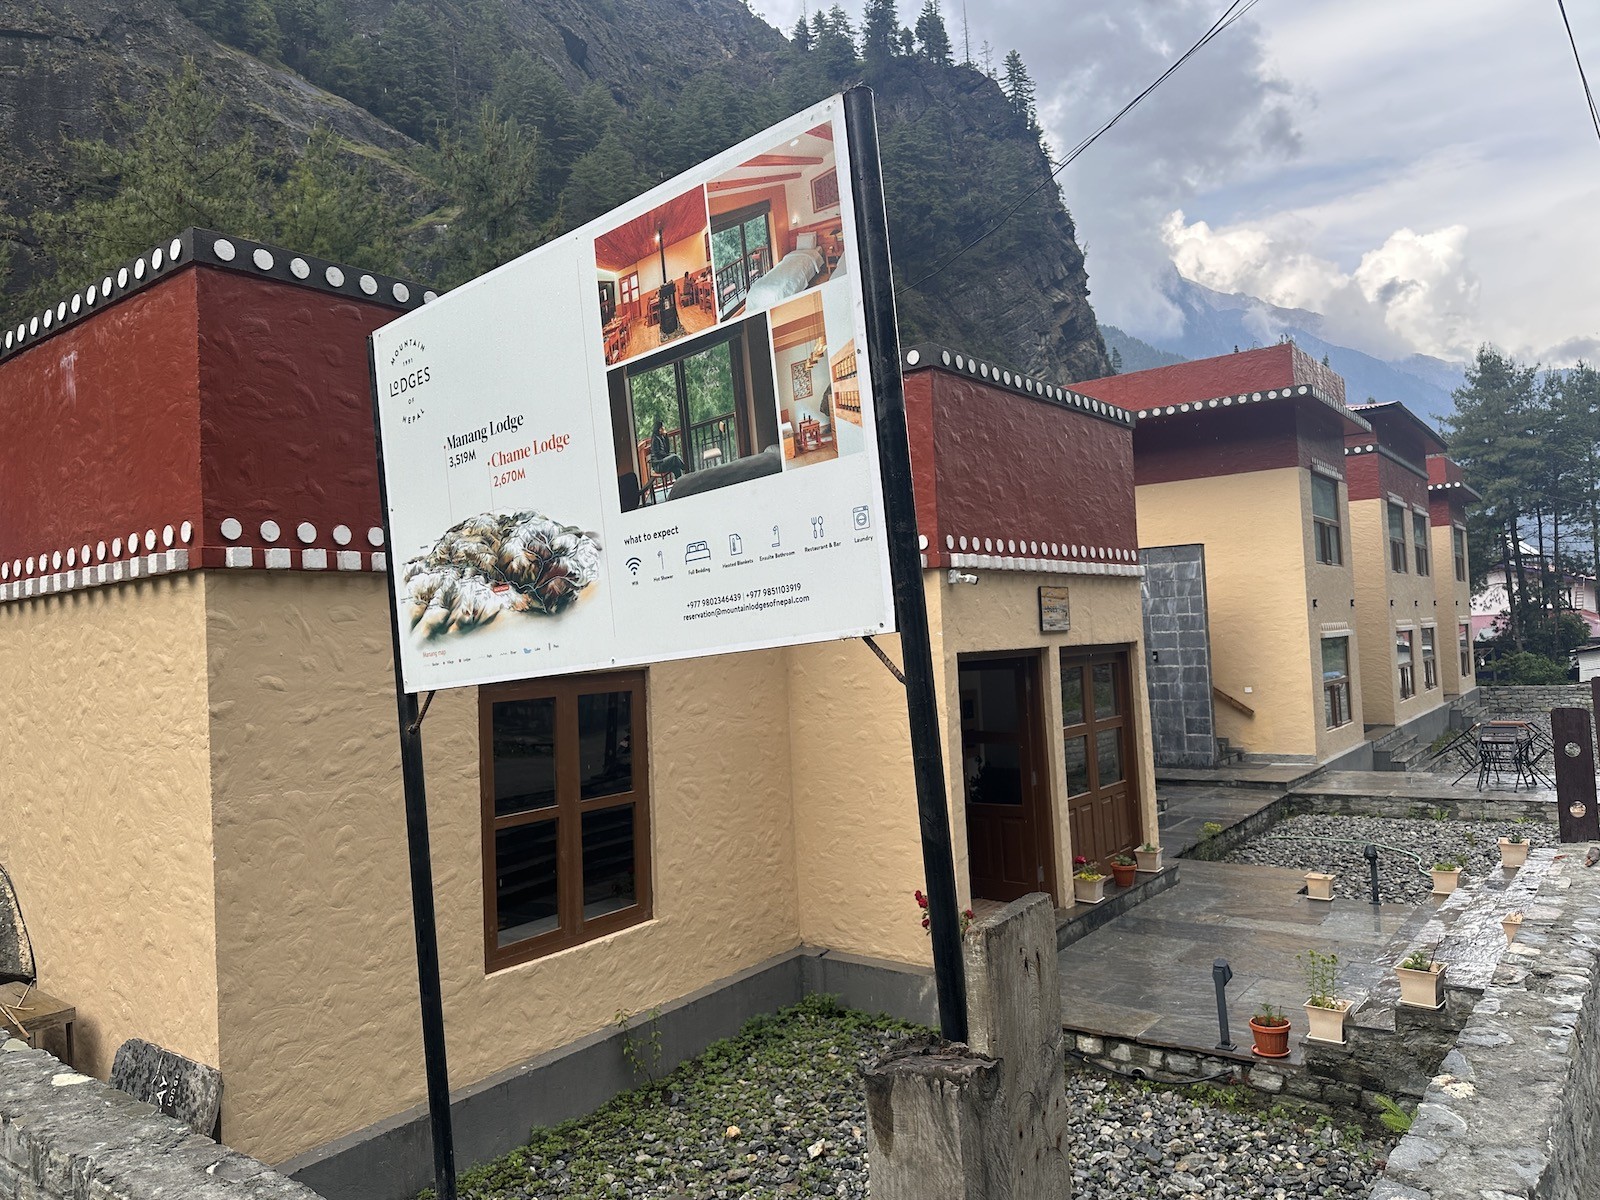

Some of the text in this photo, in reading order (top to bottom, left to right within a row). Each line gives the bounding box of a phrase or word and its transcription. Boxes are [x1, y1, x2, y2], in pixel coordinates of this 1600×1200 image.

[391, 339, 425, 366] MOUNTAIN
[408, 397, 415, 405] OF
[402, 408, 425, 424] NEPAL
[447, 414, 524, 451] Manang Lodge
[449, 448, 477, 468] 3,519M
[491, 433, 570, 468] Chame Lodge
[493, 468, 526, 488] 2,670M
[623, 525, 679, 545] what to expect
[853, 534, 873, 544] Laundry
[759, 550, 796, 562] Ensuite Bathroom
[804, 543, 828, 553] Restaurant
[737, 558, 754, 566] Blankets
[686, 600, 701, 609] +977
[702, 593, 742, 607] 9802346439
[746, 589, 761, 599] +977
[762, 582, 802, 597] 9851103919
[683, 595, 810, 621] reservation@mountainlodgesofnepal.com
